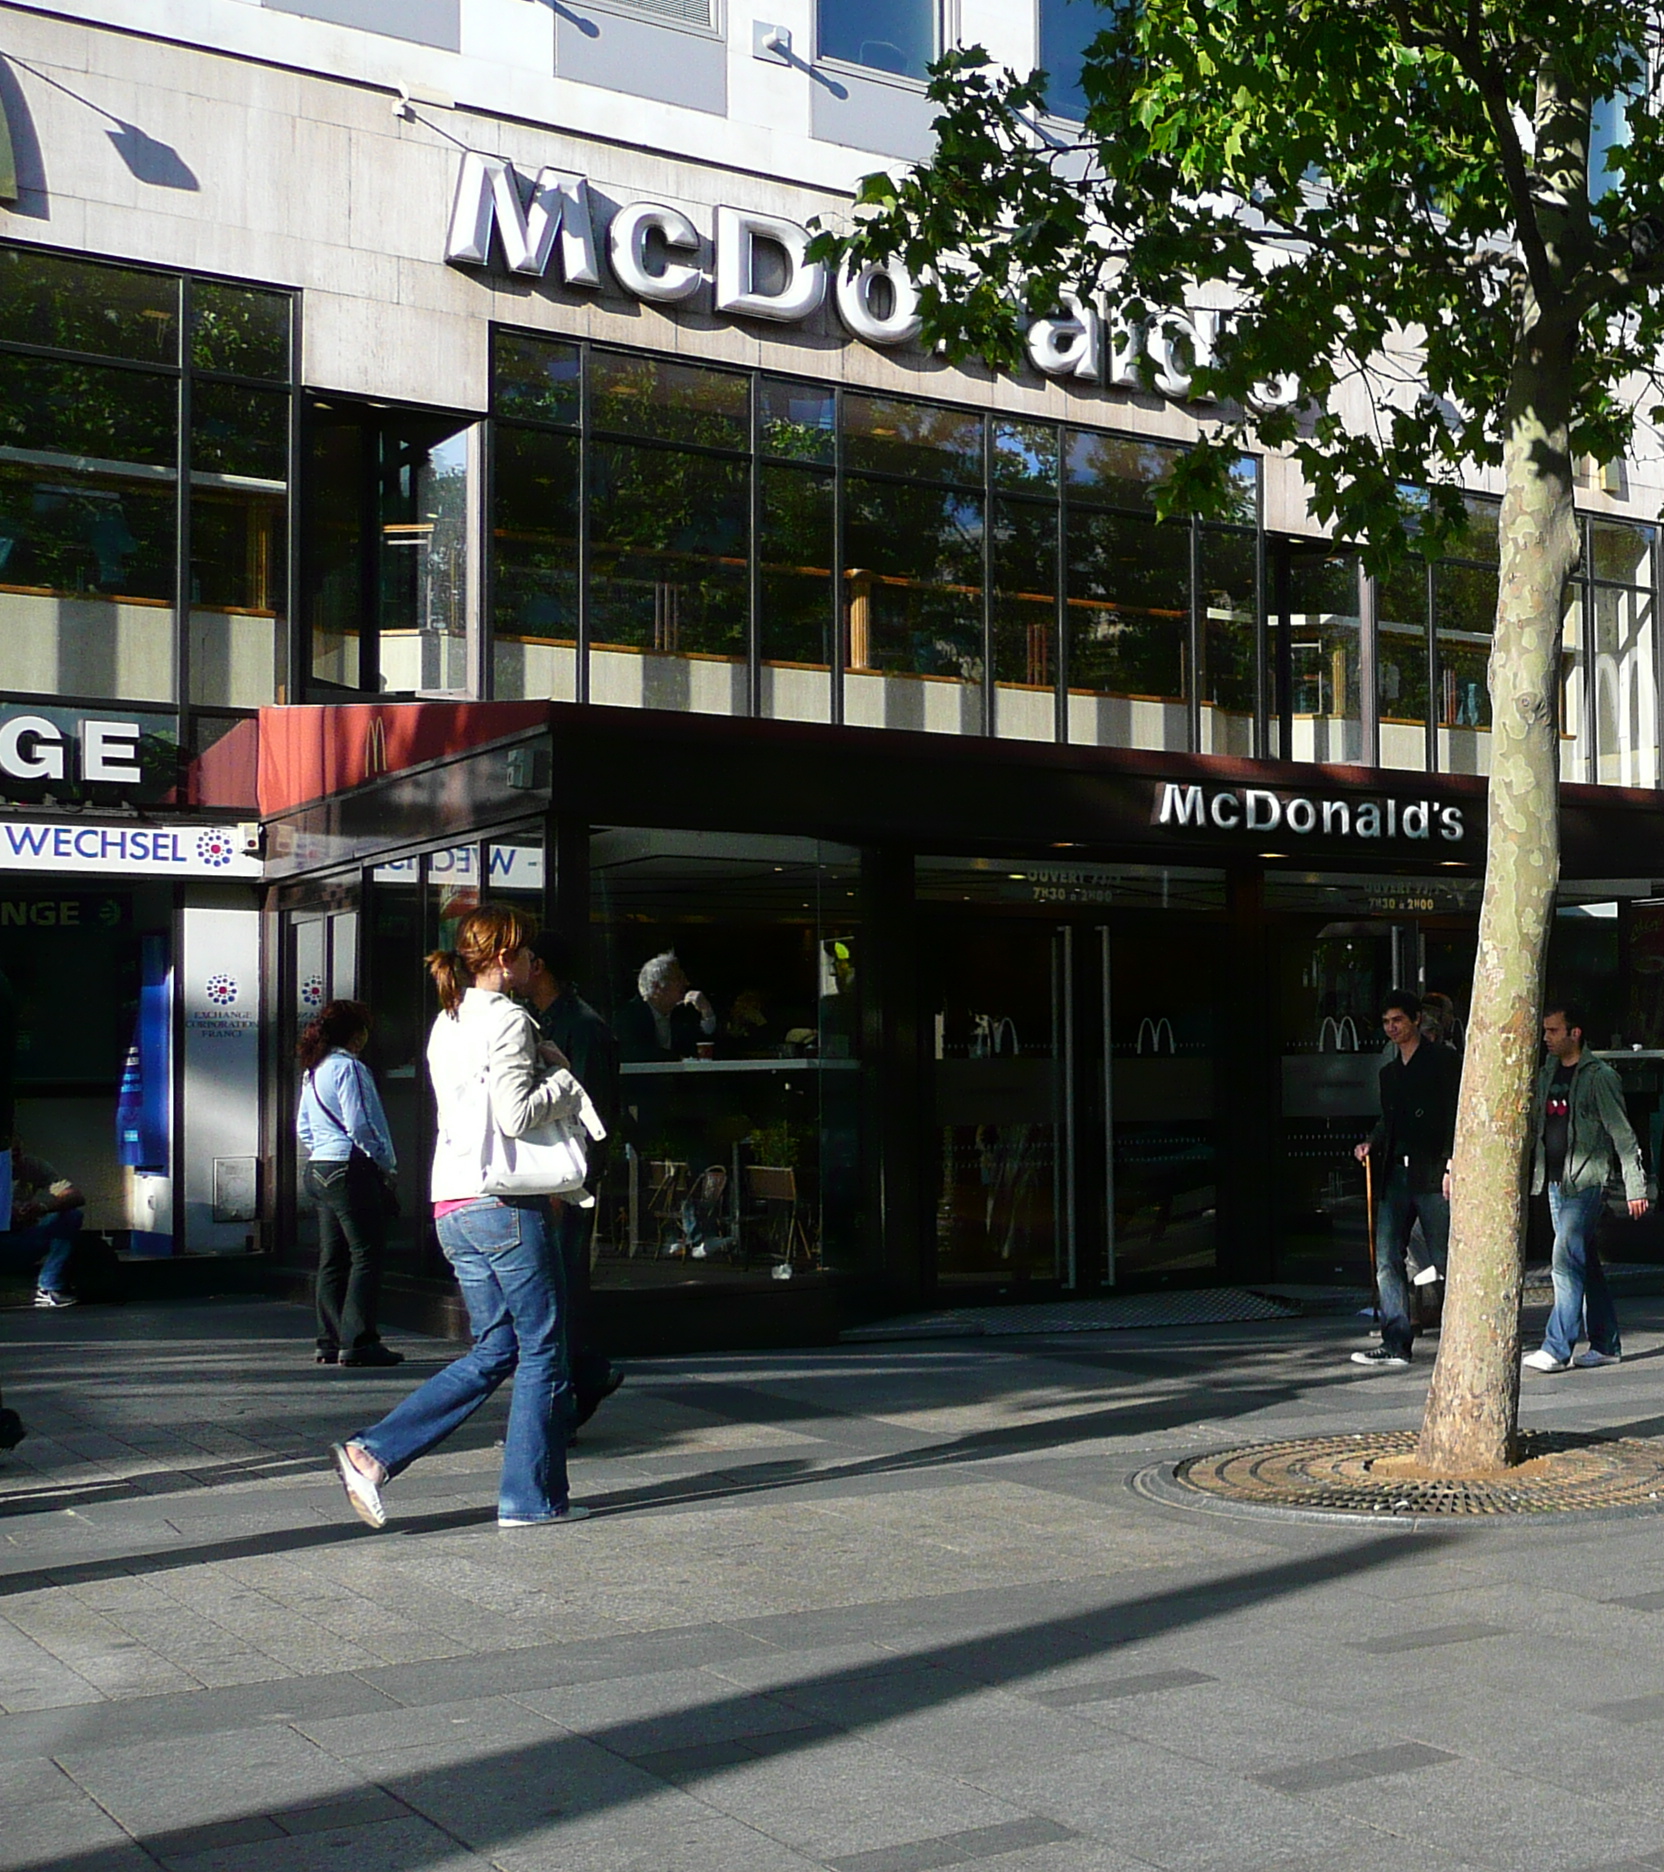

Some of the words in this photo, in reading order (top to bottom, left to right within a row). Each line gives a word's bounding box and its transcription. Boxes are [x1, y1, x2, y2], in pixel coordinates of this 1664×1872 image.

[445, 150, 1302, 412] McDoald
[0, 714, 141, 784] GE
[1158, 783, 1465, 841] McDonald's
[4, 826, 188, 862] WECHSEL
[1027, 868, 1084, 884] OUVERT
[0, 900, 81, 927] NGE
[1407, 898, 1434, 911] 2H00
[185, 1020, 259, 1029] CORPORATION
[193, 1010, 253, 1020] EXCHANGE
